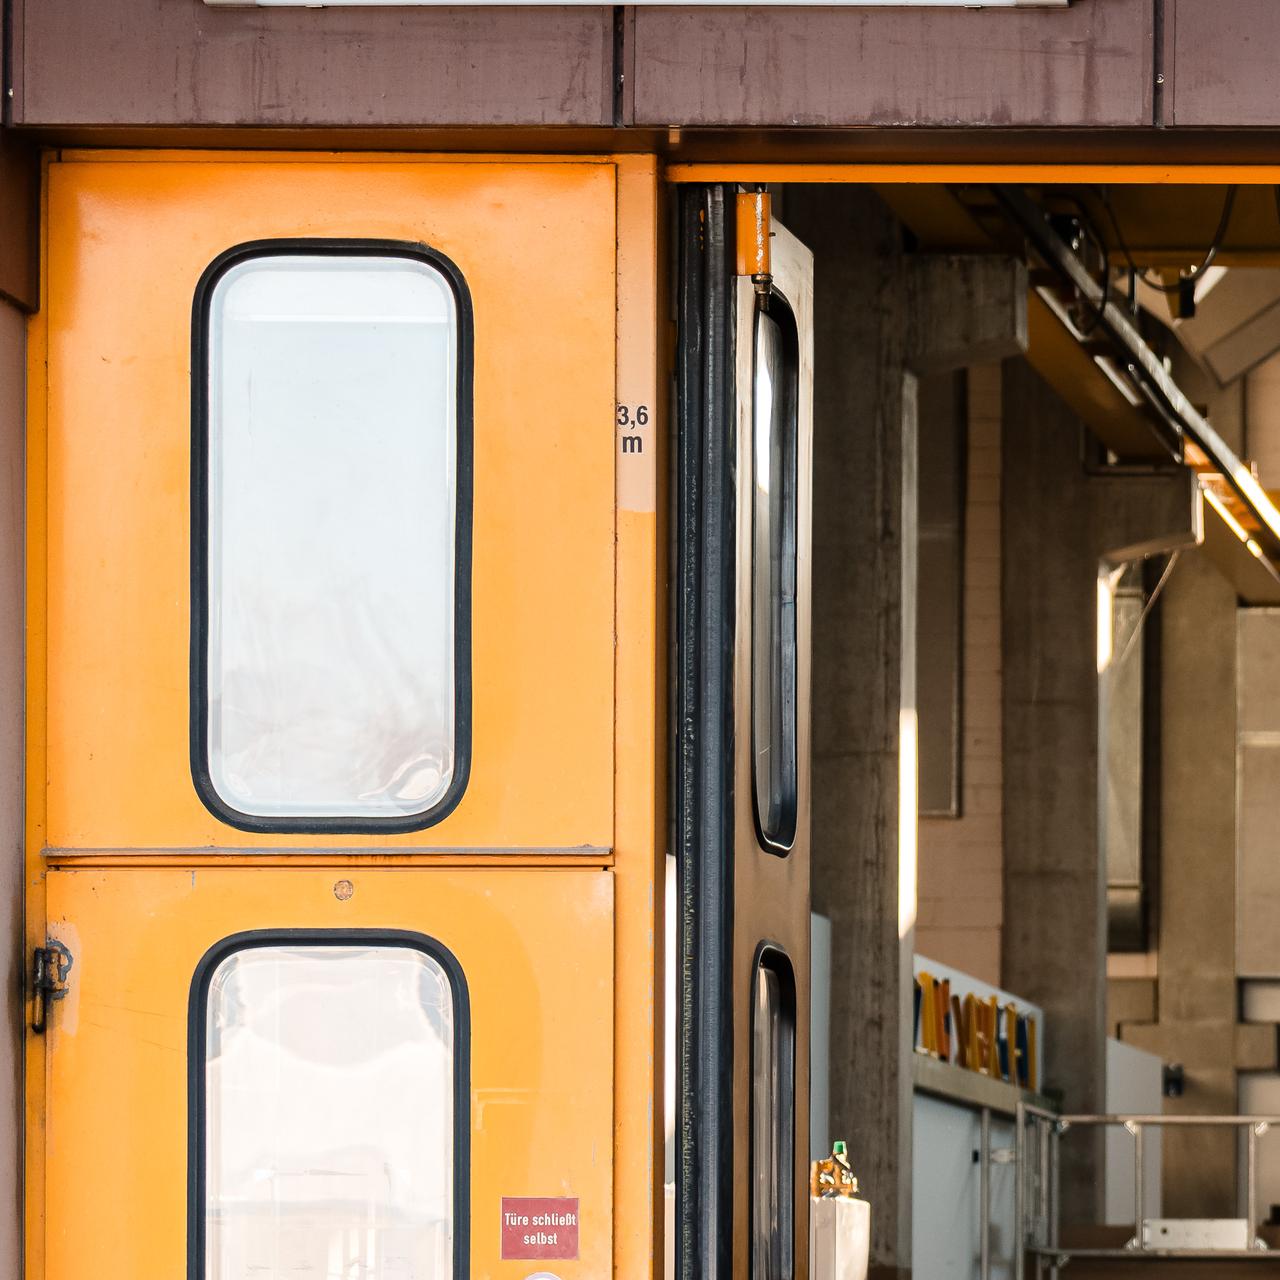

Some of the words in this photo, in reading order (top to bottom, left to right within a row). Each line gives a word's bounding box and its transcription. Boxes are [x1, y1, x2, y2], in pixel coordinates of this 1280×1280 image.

[617, 405, 649, 430] 3,6
[622, 435, 643, 453] m
[505, 1212, 529, 1226] Türe
[532, 1212, 577, 1226] schließt
[523, 1232, 558, 1245] selbst
